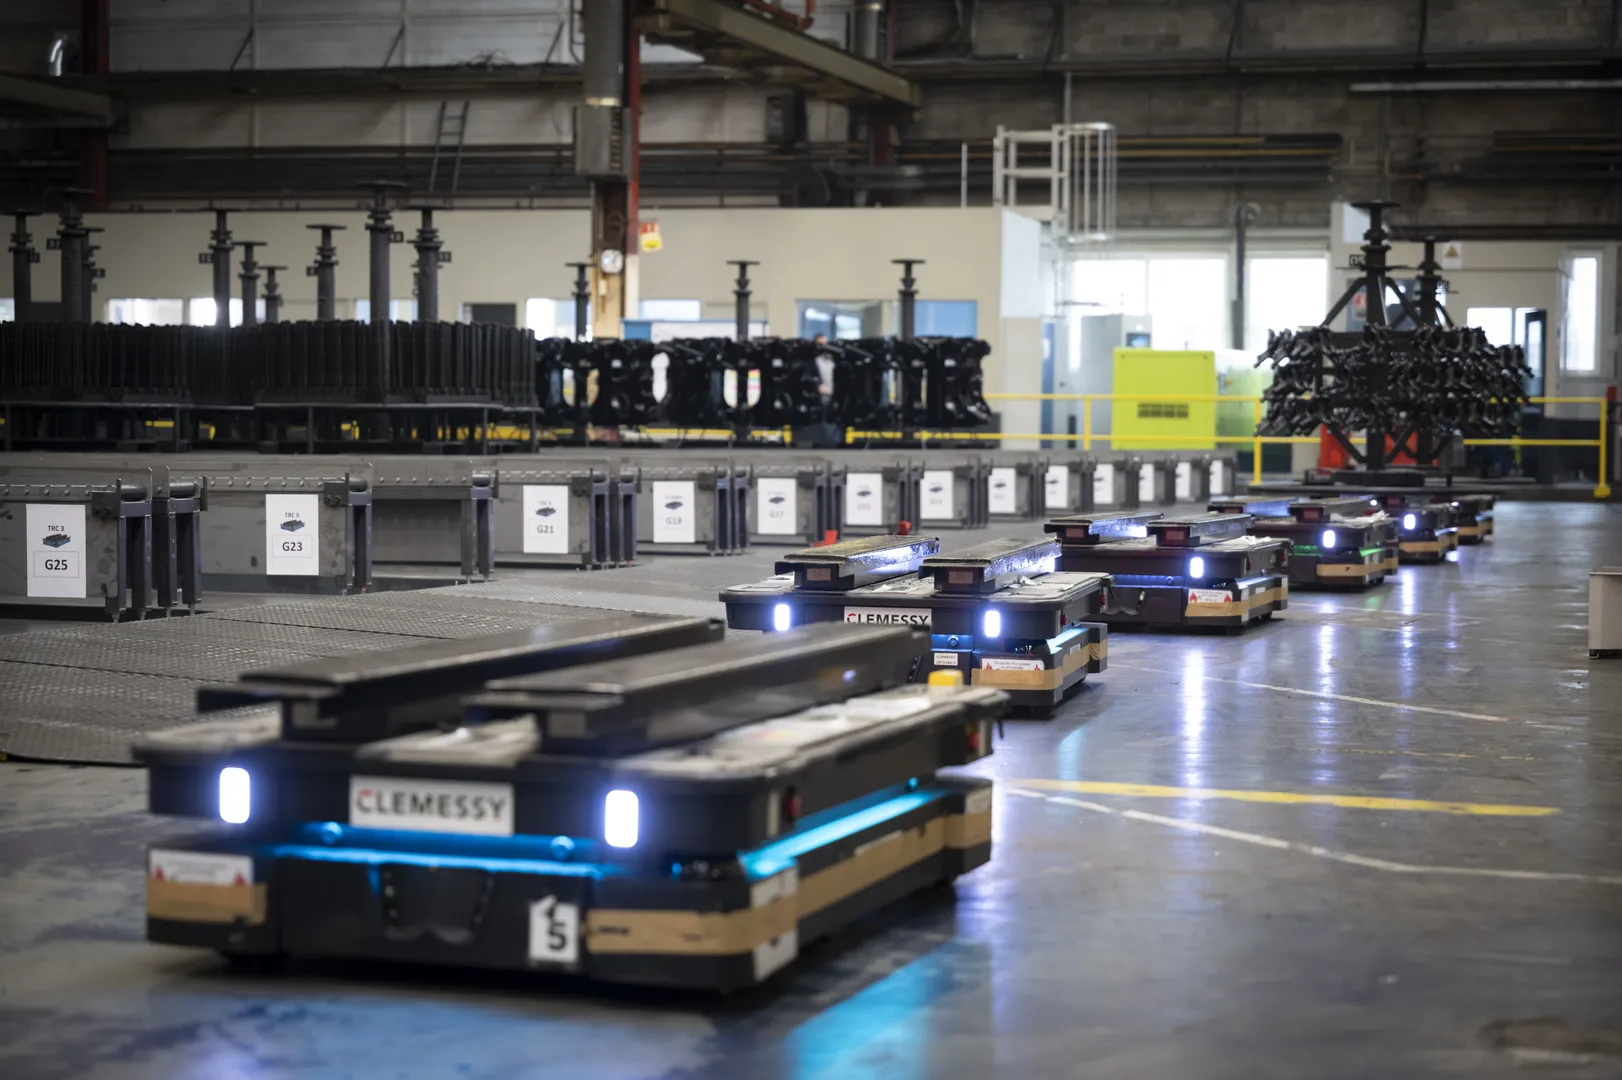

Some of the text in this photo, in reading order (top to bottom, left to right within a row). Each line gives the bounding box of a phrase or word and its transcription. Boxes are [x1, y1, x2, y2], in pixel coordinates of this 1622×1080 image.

[536, 525, 554, 534] G21
[282, 541, 303, 552] G23
[44, 559, 68, 571] G25
[846, 613, 929, 625] CLEMESSY
[355, 789, 506, 821] CLEMESSY
[548, 922, 567, 950] 5
